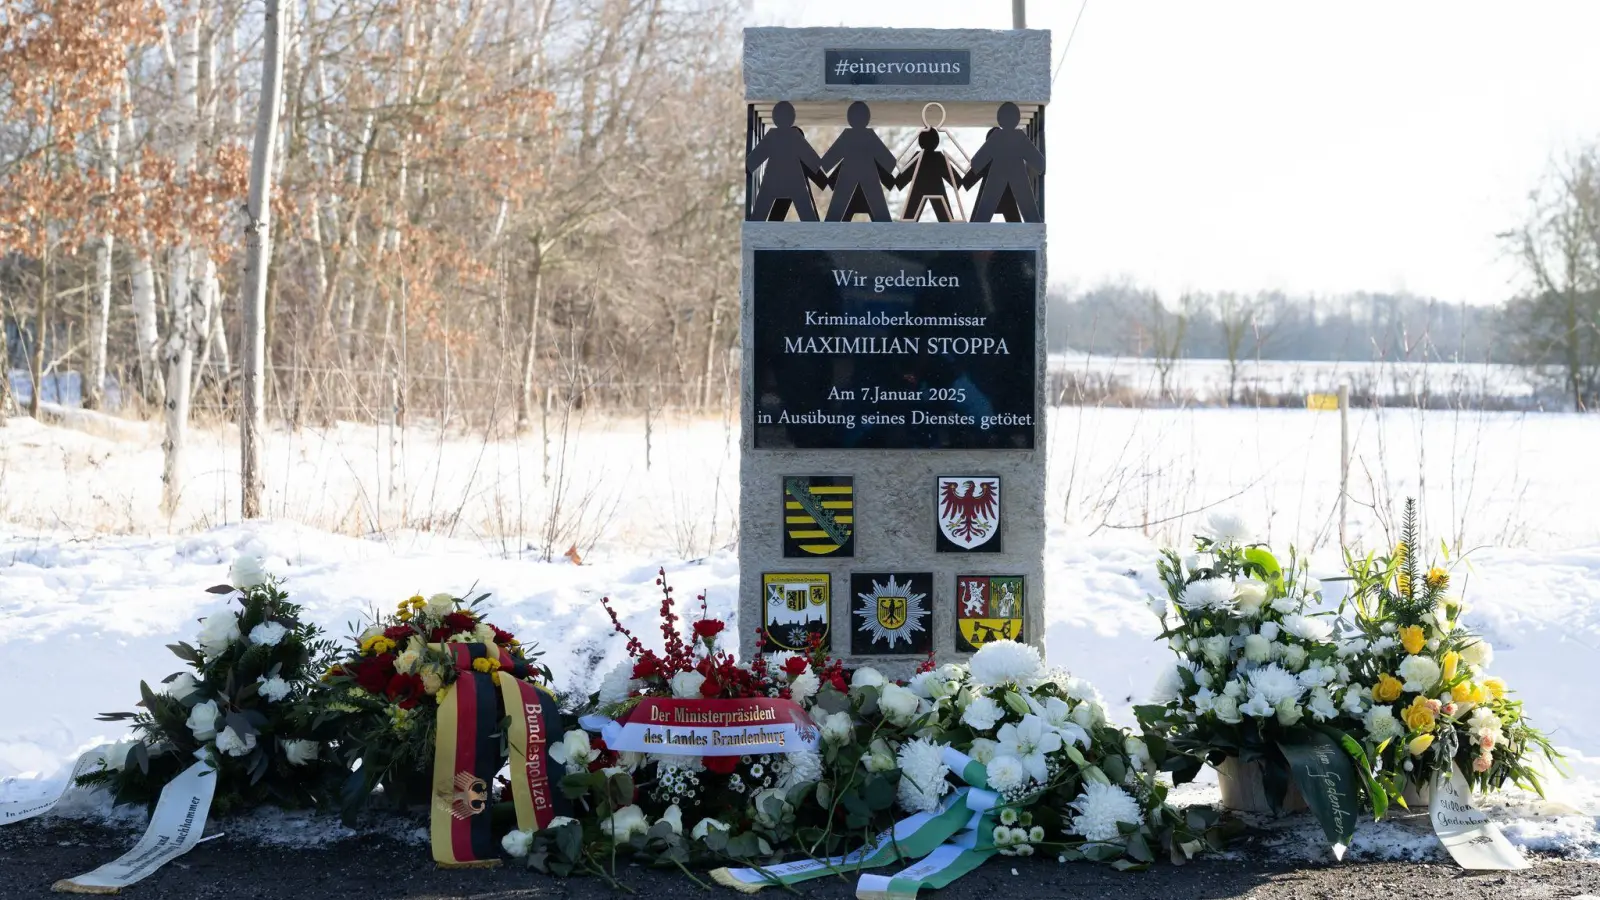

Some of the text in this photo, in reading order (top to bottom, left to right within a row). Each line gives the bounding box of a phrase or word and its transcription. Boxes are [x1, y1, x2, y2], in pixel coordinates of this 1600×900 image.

[834, 57, 961, 76] #einervonuns
[832, 269, 960, 293] Wir gedenken
[805, 311, 987, 327] Kriminaloberkommissar
[784, 336, 1010, 355] MAXIMILIAN STOPPA
[827, 386, 855, 401] Am
[929, 387, 966, 403] 2025
[758, 410, 1035, 430] in Ausübung seines Dienstes getötet.
[651, 704, 776, 727] Der Ministerpräsident
[643, 728, 785, 747] des Landes Brandenburg
[525, 703, 553, 811] Bundespolizei
